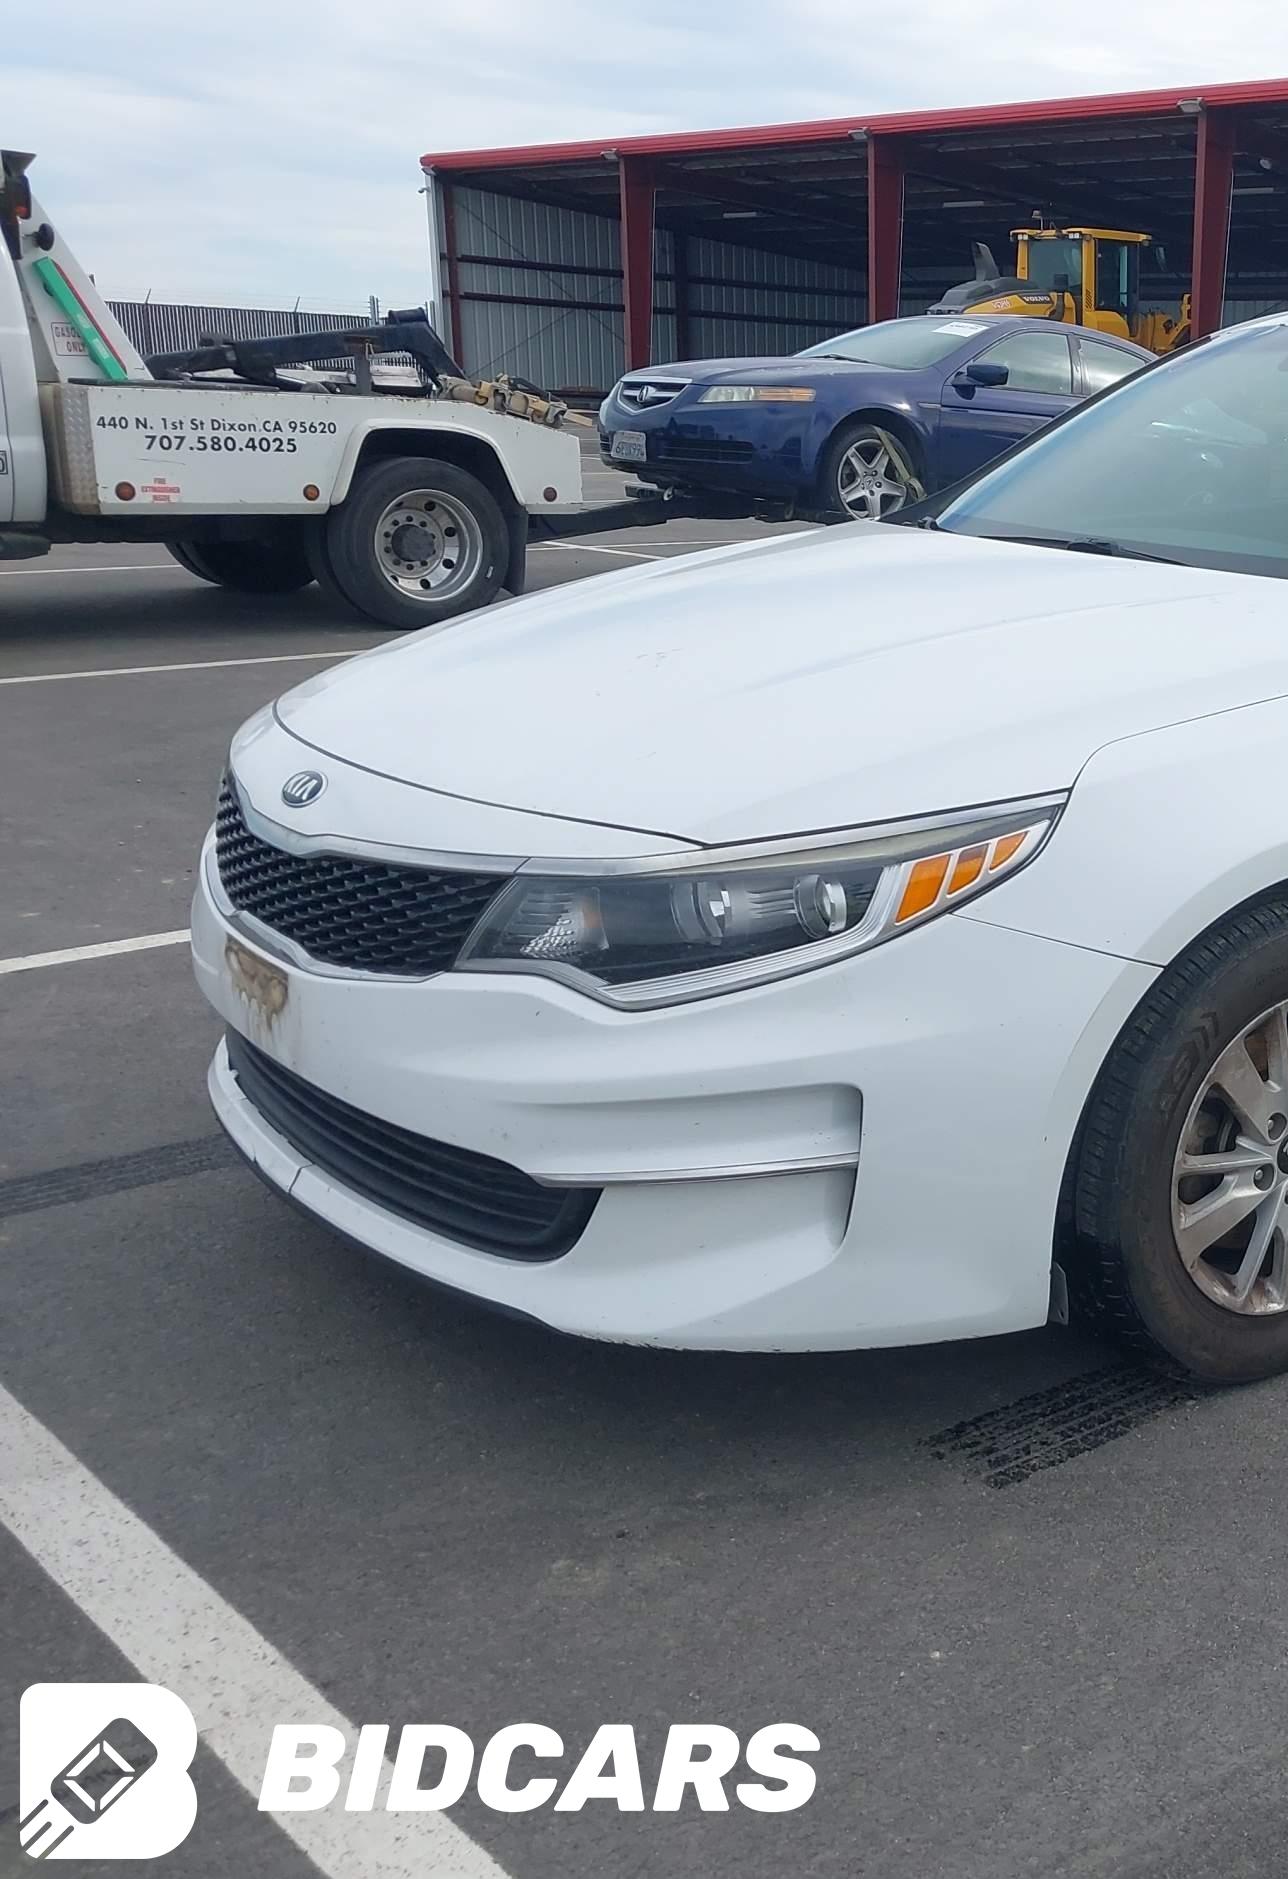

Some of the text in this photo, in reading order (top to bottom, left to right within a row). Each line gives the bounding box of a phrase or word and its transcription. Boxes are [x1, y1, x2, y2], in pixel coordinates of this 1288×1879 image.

[96, 416, 129, 430] 440
[134, 416, 154, 430] N.
[161, 417, 185, 431] 1st
[190, 418, 205, 431] St
[288, 420, 337, 434] 95620
[144, 434, 298, 453] 707.580.4025
[284, 773, 318, 801] KIA
